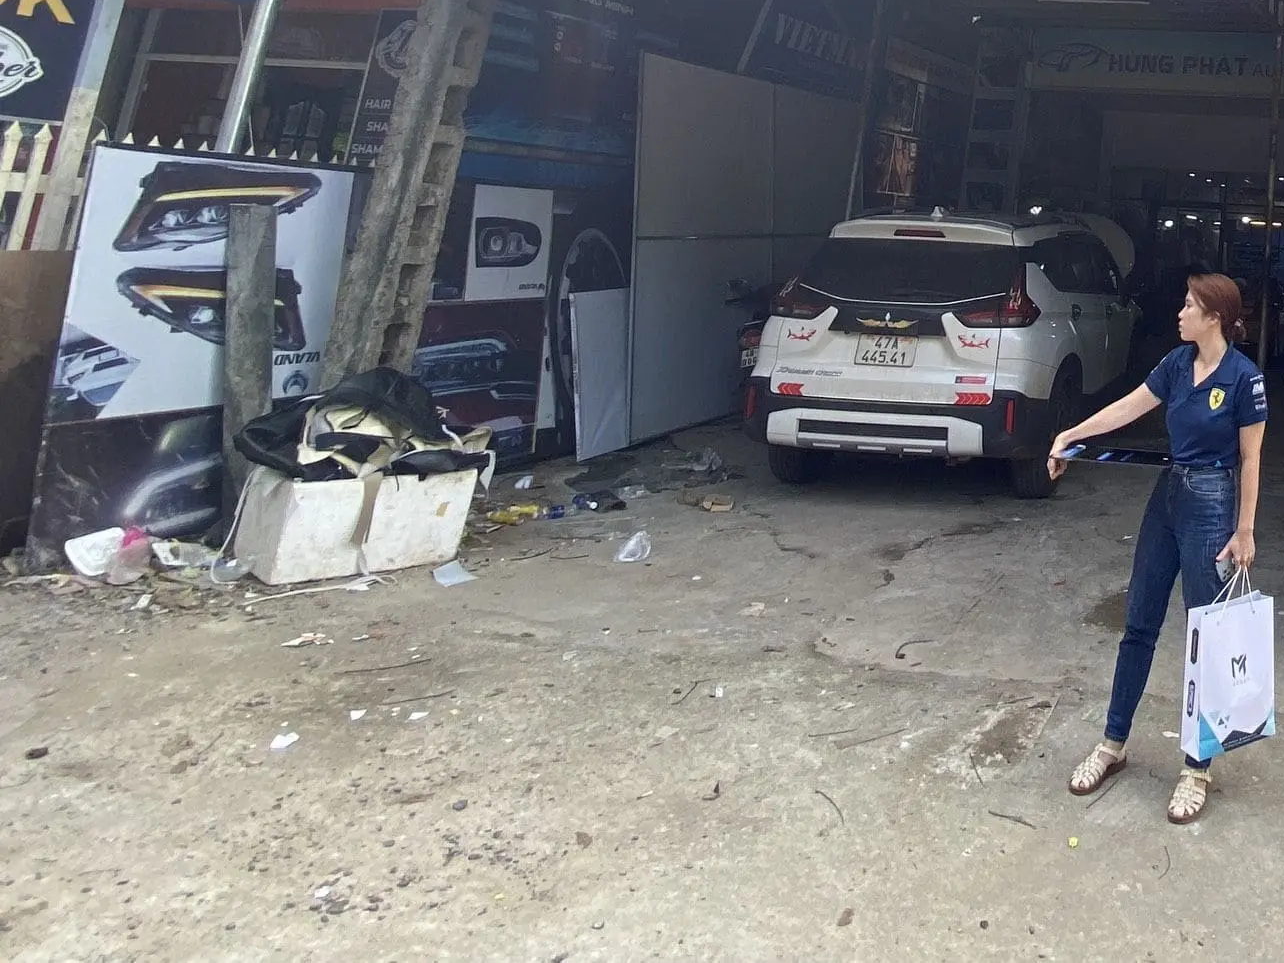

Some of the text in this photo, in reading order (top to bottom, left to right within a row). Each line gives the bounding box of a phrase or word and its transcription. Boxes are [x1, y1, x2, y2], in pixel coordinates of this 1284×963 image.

[364, 99, 392, 110] HAIR
[366, 121, 389, 132] SHA
[351, 143, 385, 155] SHAM
[874, 336, 899, 350] 47A
[861, 350, 906, 365] 445.41
